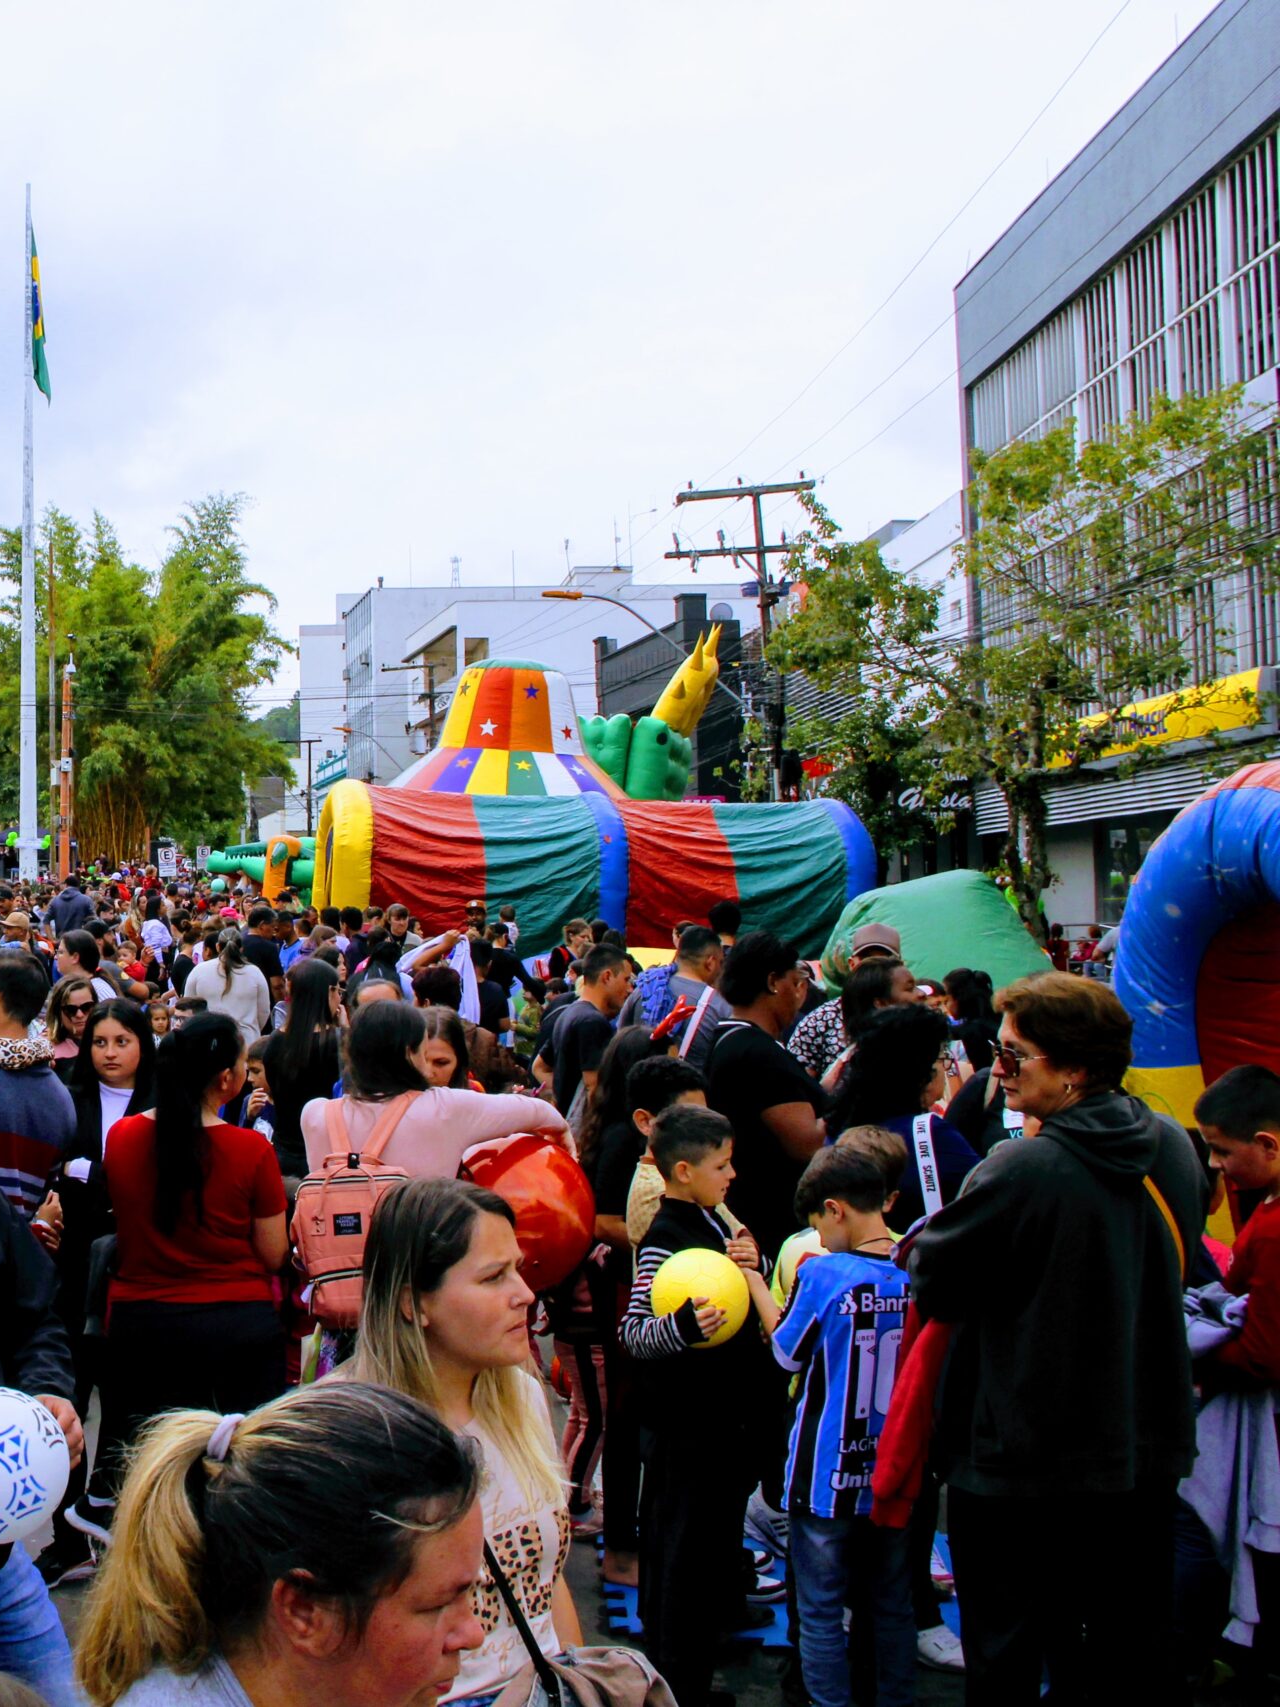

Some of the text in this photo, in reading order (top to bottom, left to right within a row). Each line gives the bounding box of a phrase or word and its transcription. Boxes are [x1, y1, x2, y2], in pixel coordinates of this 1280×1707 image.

[916, 1120, 937, 1193] LIVE LOVE SCHUTZ
